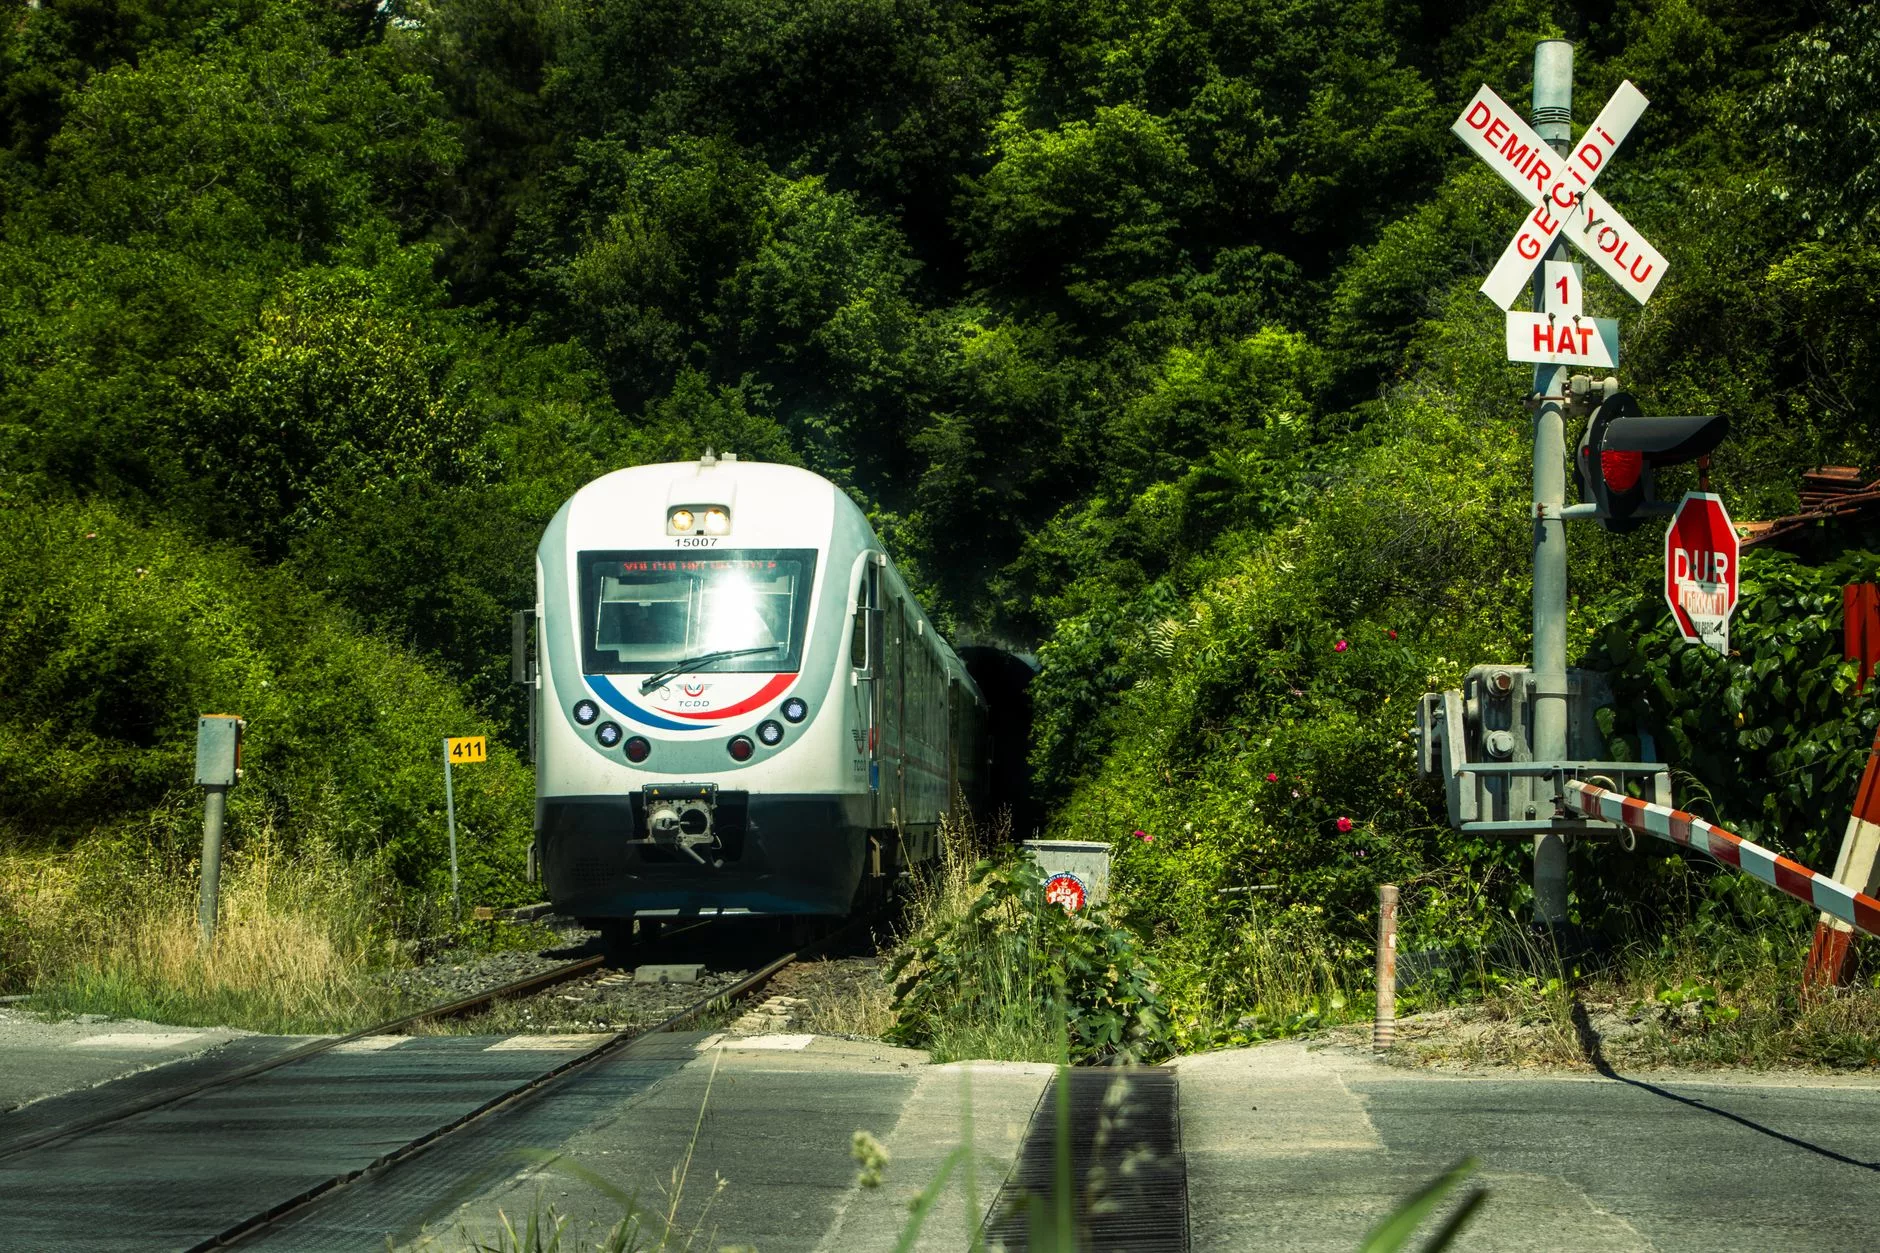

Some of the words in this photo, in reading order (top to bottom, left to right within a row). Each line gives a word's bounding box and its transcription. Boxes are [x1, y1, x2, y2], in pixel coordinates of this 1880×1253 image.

[1465, 100, 1552, 192] DEMİR
[1583, 207, 1653, 283] YOLU
[1555, 276, 1568, 304] 1
[1533, 323, 1594, 356] HAT
[674, 537, 718, 547] 15007
[1674, 547, 1729, 584] DUR
[452, 741, 482, 757] 411
